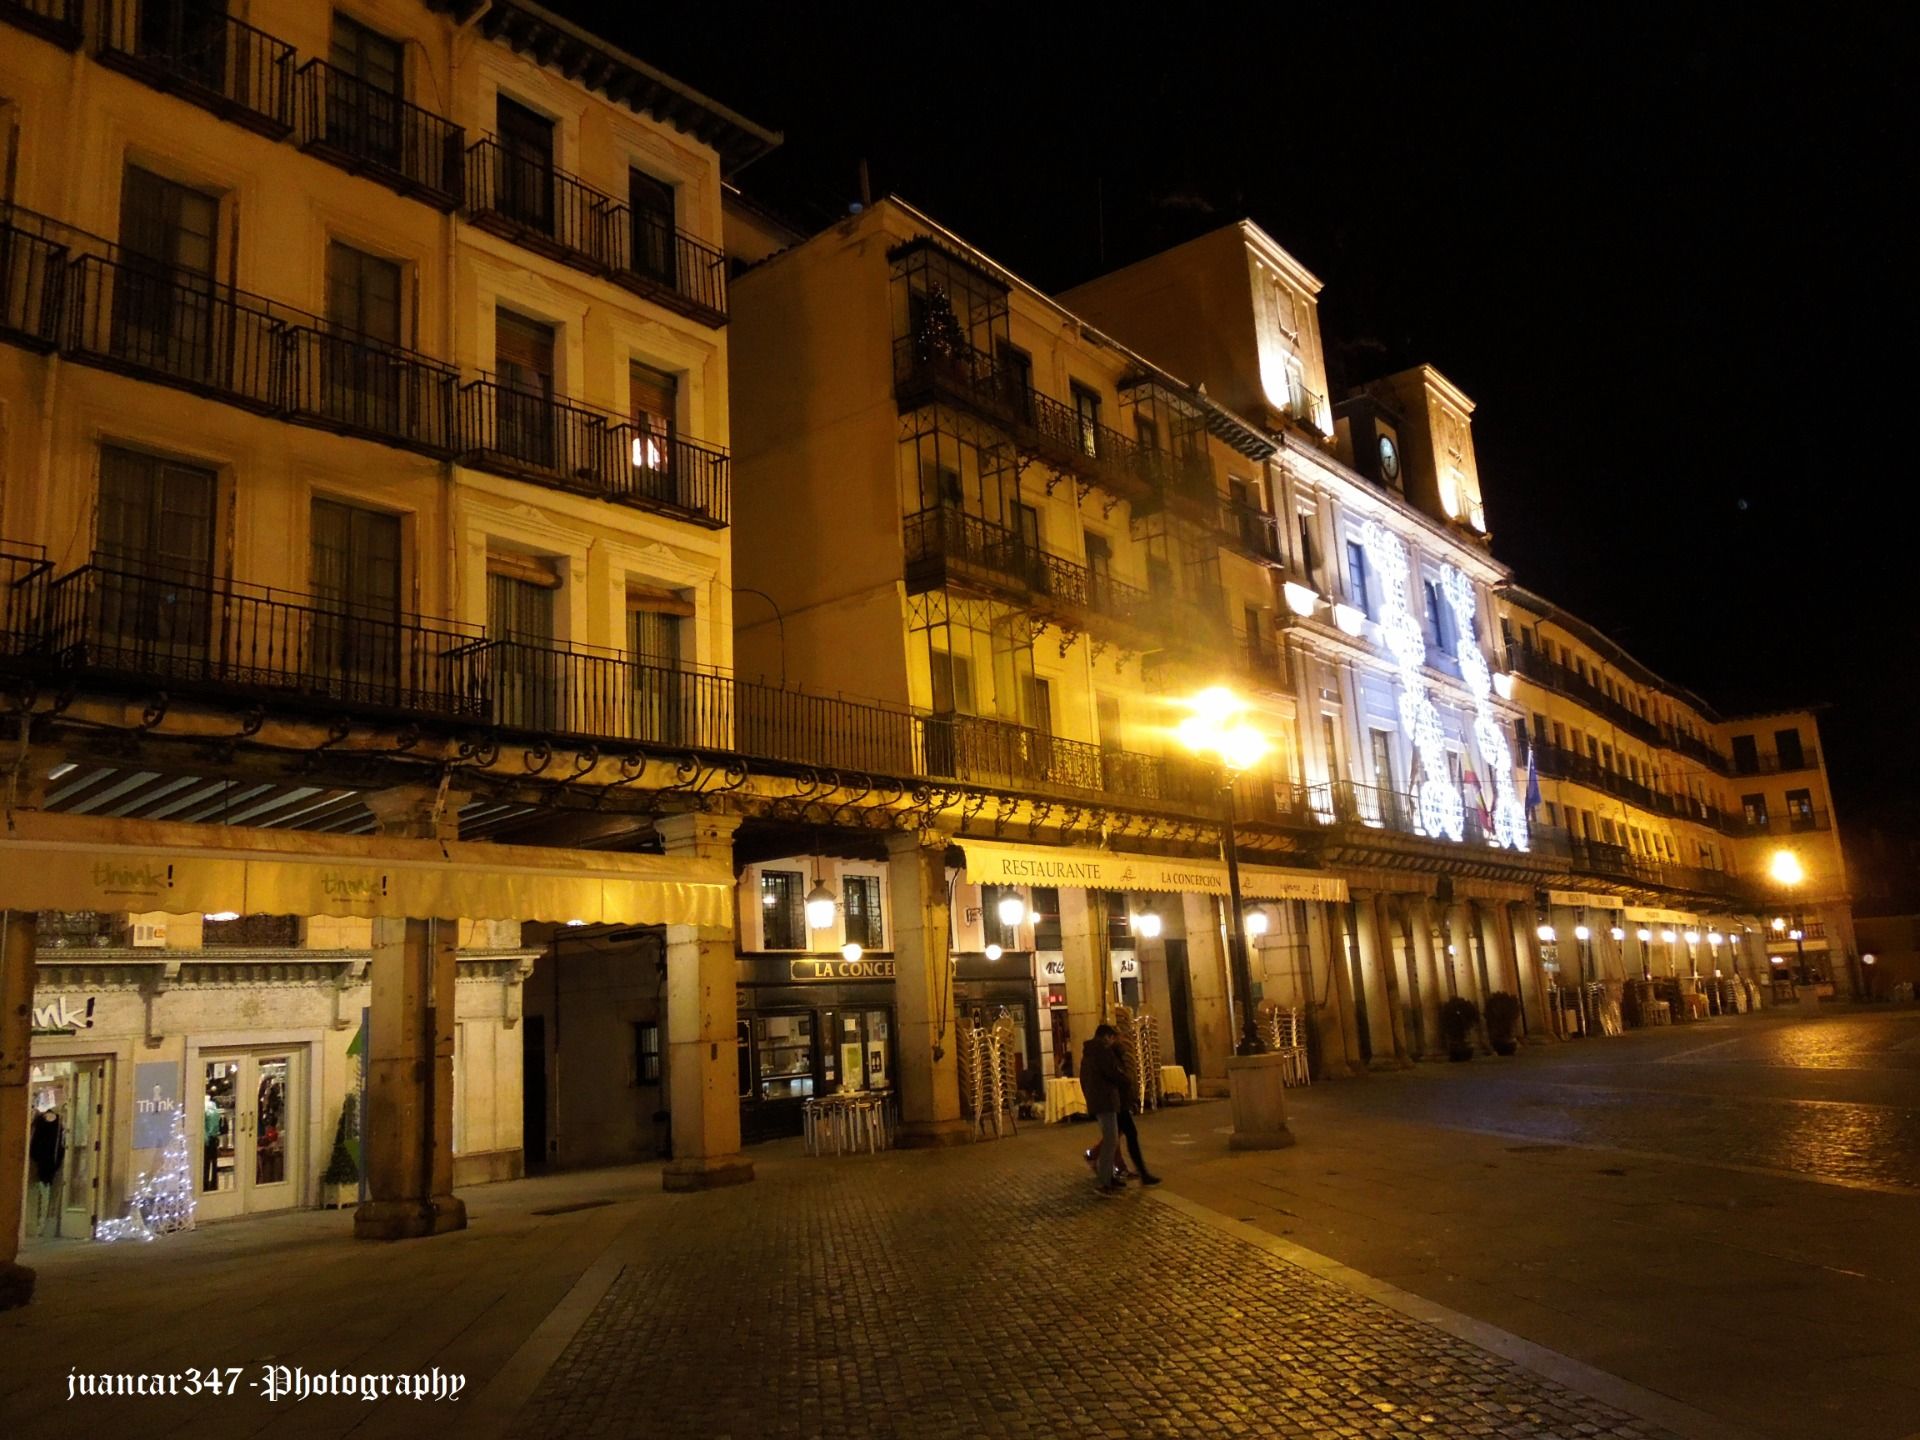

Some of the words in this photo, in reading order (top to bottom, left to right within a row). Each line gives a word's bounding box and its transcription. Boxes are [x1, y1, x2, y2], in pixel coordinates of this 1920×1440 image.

[1002, 859, 1101, 880] RESTAURANTE
[1161, 871, 1172, 884] LA
[814, 962, 835, 977] LA
[32, 996, 95, 1029] nk!
